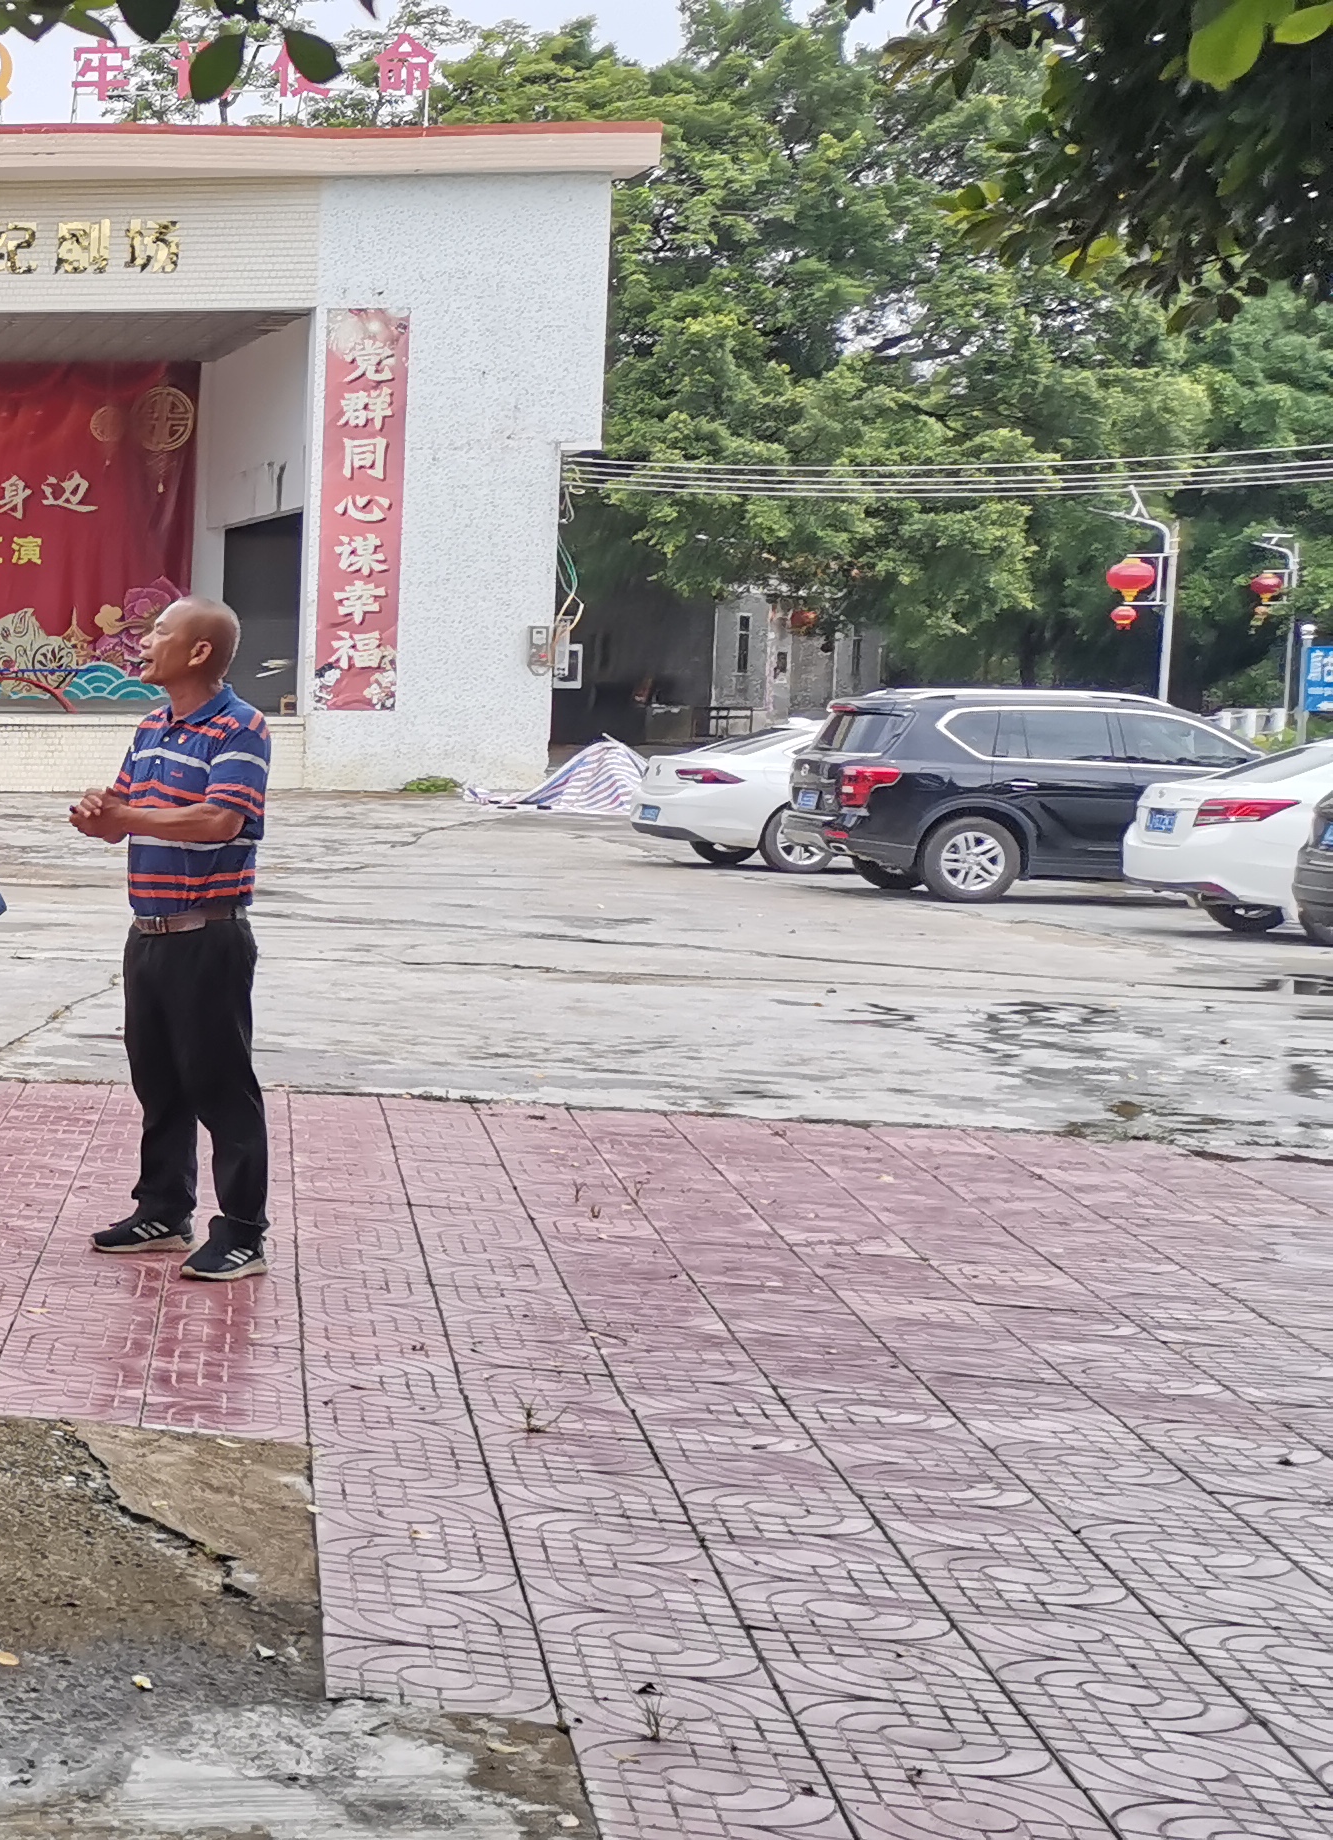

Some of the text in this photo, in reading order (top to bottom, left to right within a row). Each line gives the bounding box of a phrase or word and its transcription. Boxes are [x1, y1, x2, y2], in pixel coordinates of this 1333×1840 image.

[331, 341, 395, 670] 党群同心谋幸福
